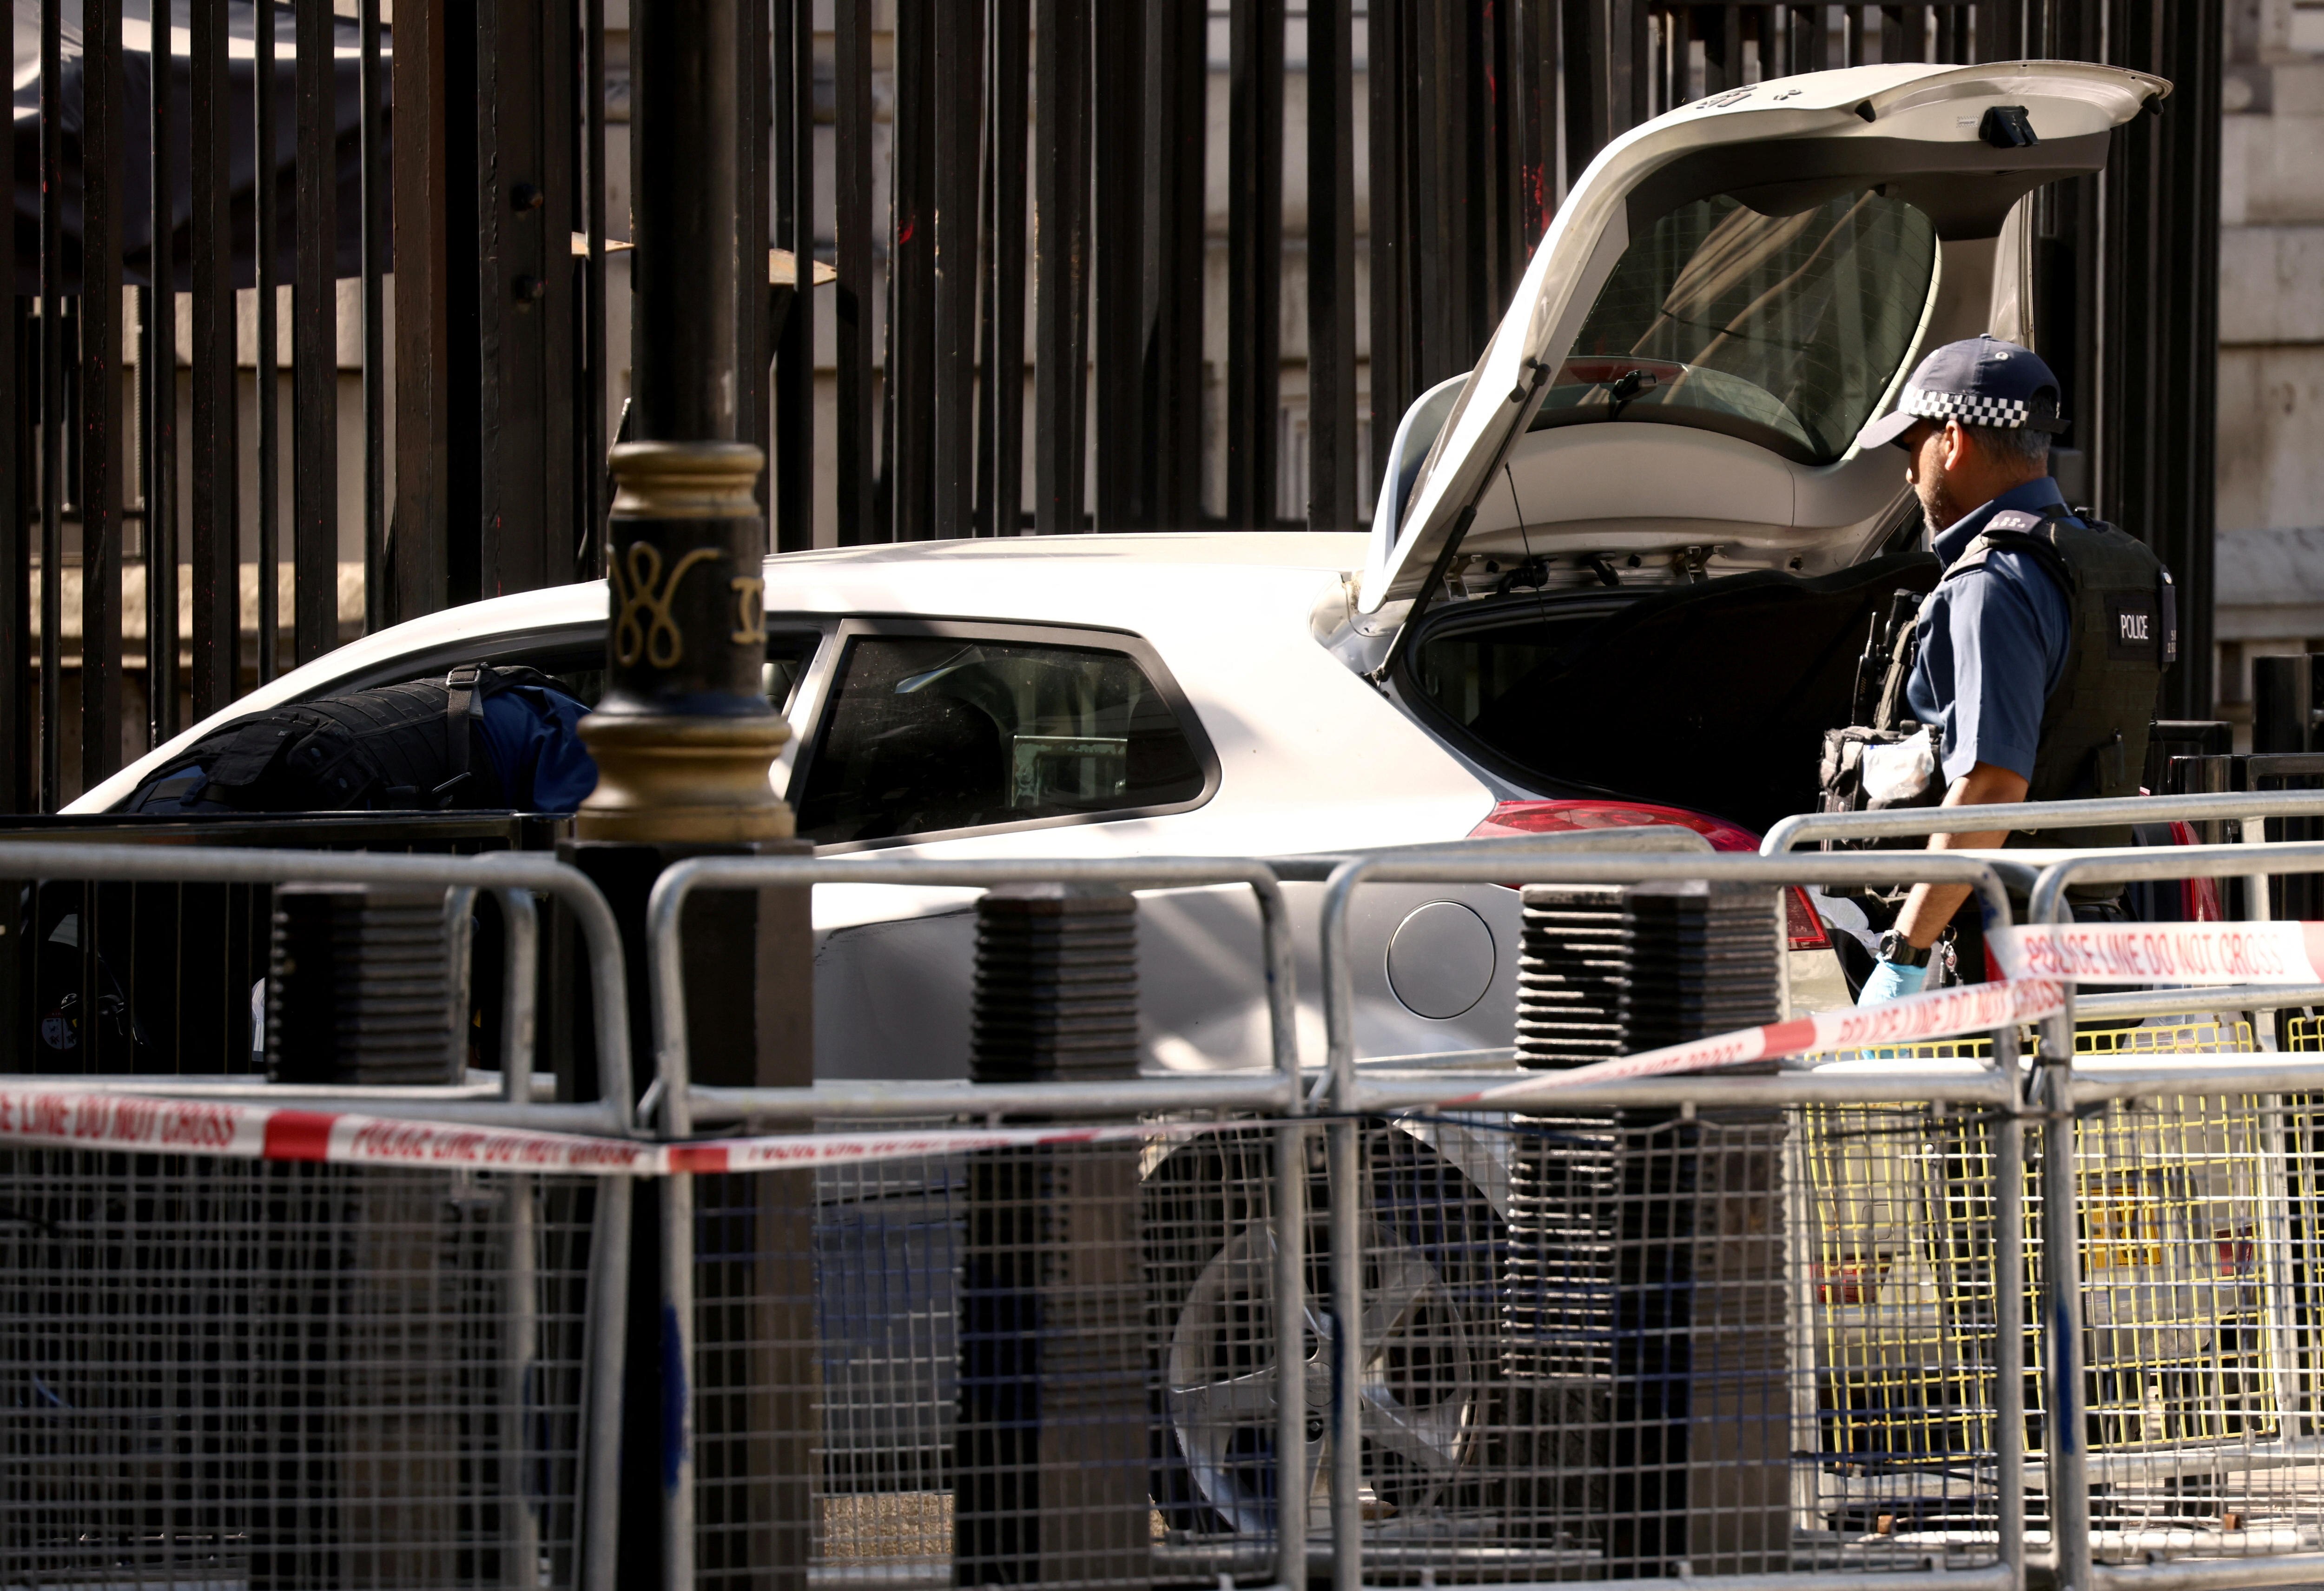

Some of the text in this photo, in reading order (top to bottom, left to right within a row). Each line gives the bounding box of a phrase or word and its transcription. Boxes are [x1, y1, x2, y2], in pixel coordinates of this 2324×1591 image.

[2120, 614, 2149, 640] POLICE
[2025, 934, 2284, 975] POLICE LINE DO NOT CROSS
